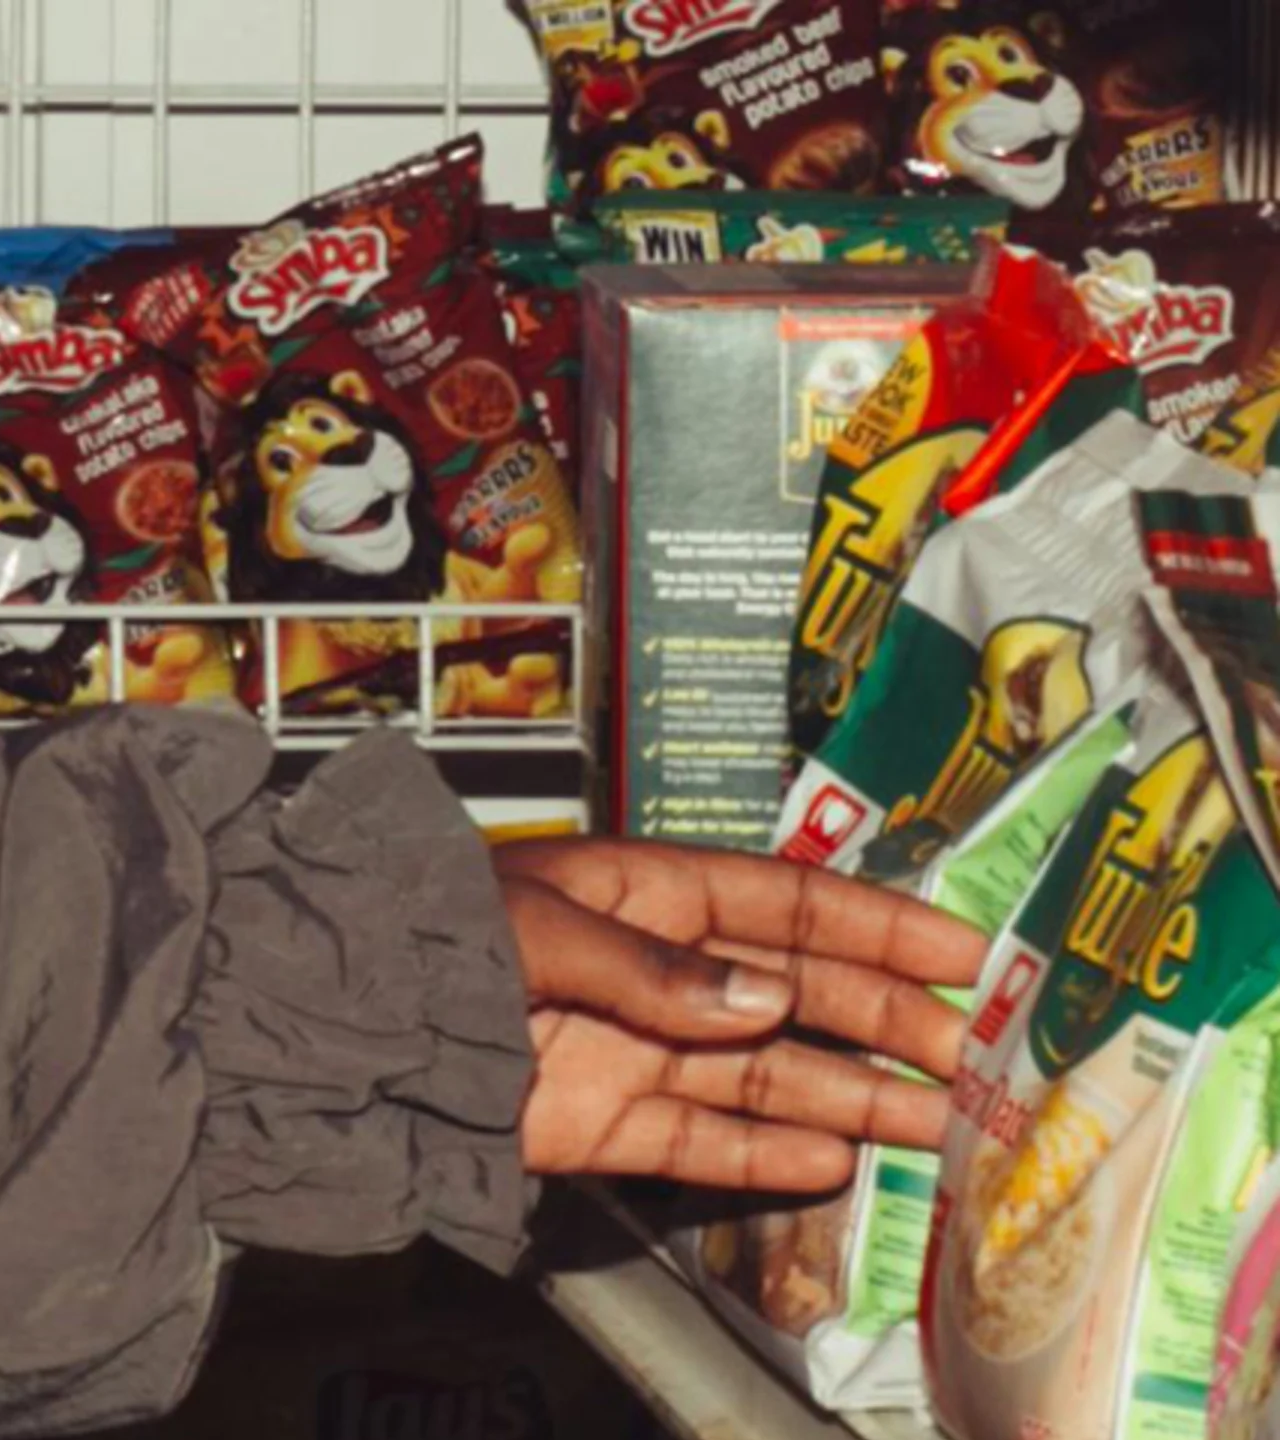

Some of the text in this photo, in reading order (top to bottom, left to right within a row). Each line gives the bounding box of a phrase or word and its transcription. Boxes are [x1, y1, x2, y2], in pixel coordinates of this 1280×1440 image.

[700, 33, 790, 88] smoked
[720, 41, 831, 107] flavoured
[744, 78, 821, 130] potato
[639, 225, 705, 262] WIN
[236, 230, 384, 330] Simba
